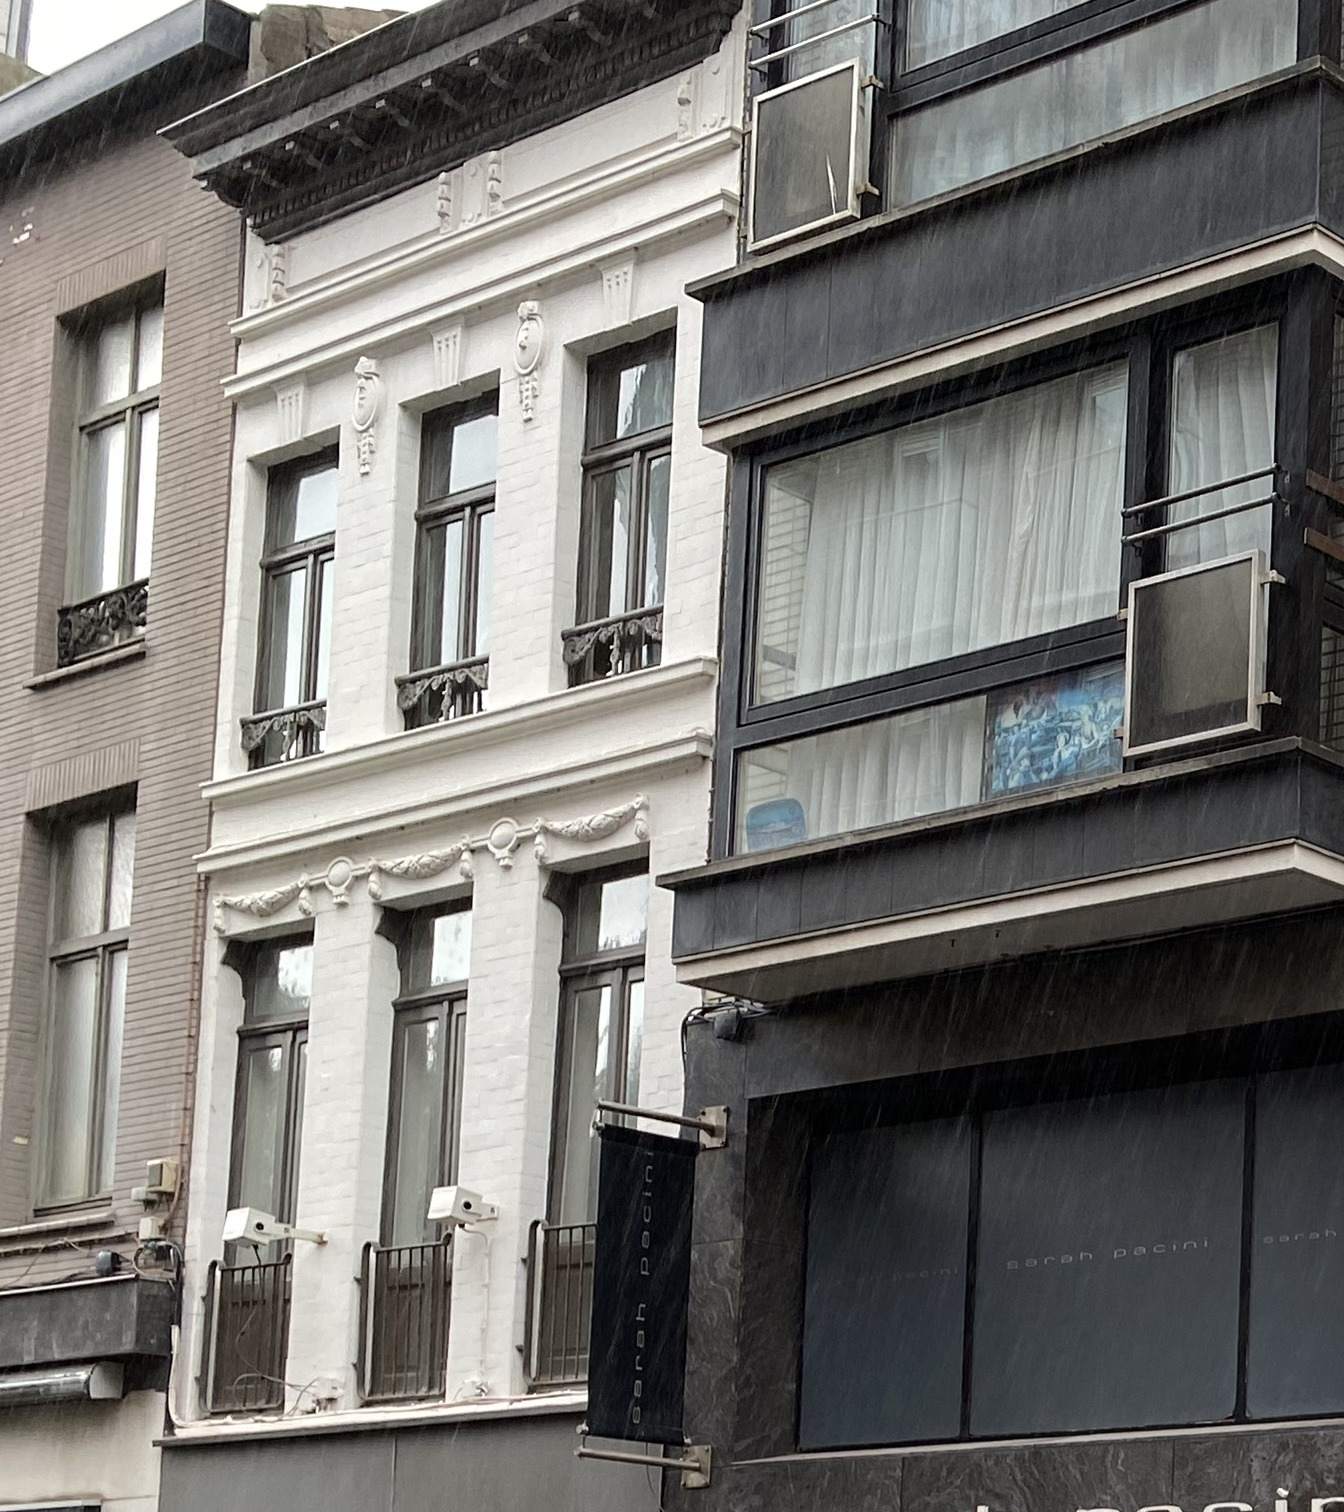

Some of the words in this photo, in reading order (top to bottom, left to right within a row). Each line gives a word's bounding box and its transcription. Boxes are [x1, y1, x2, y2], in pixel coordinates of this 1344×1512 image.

[1263, 1228, 1337, 1245] sarah
[1007, 1251, 1093, 1270] sarah
[1113, 1237, 1209, 1260] pacini
[632, 1303, 646, 1424] sarah
